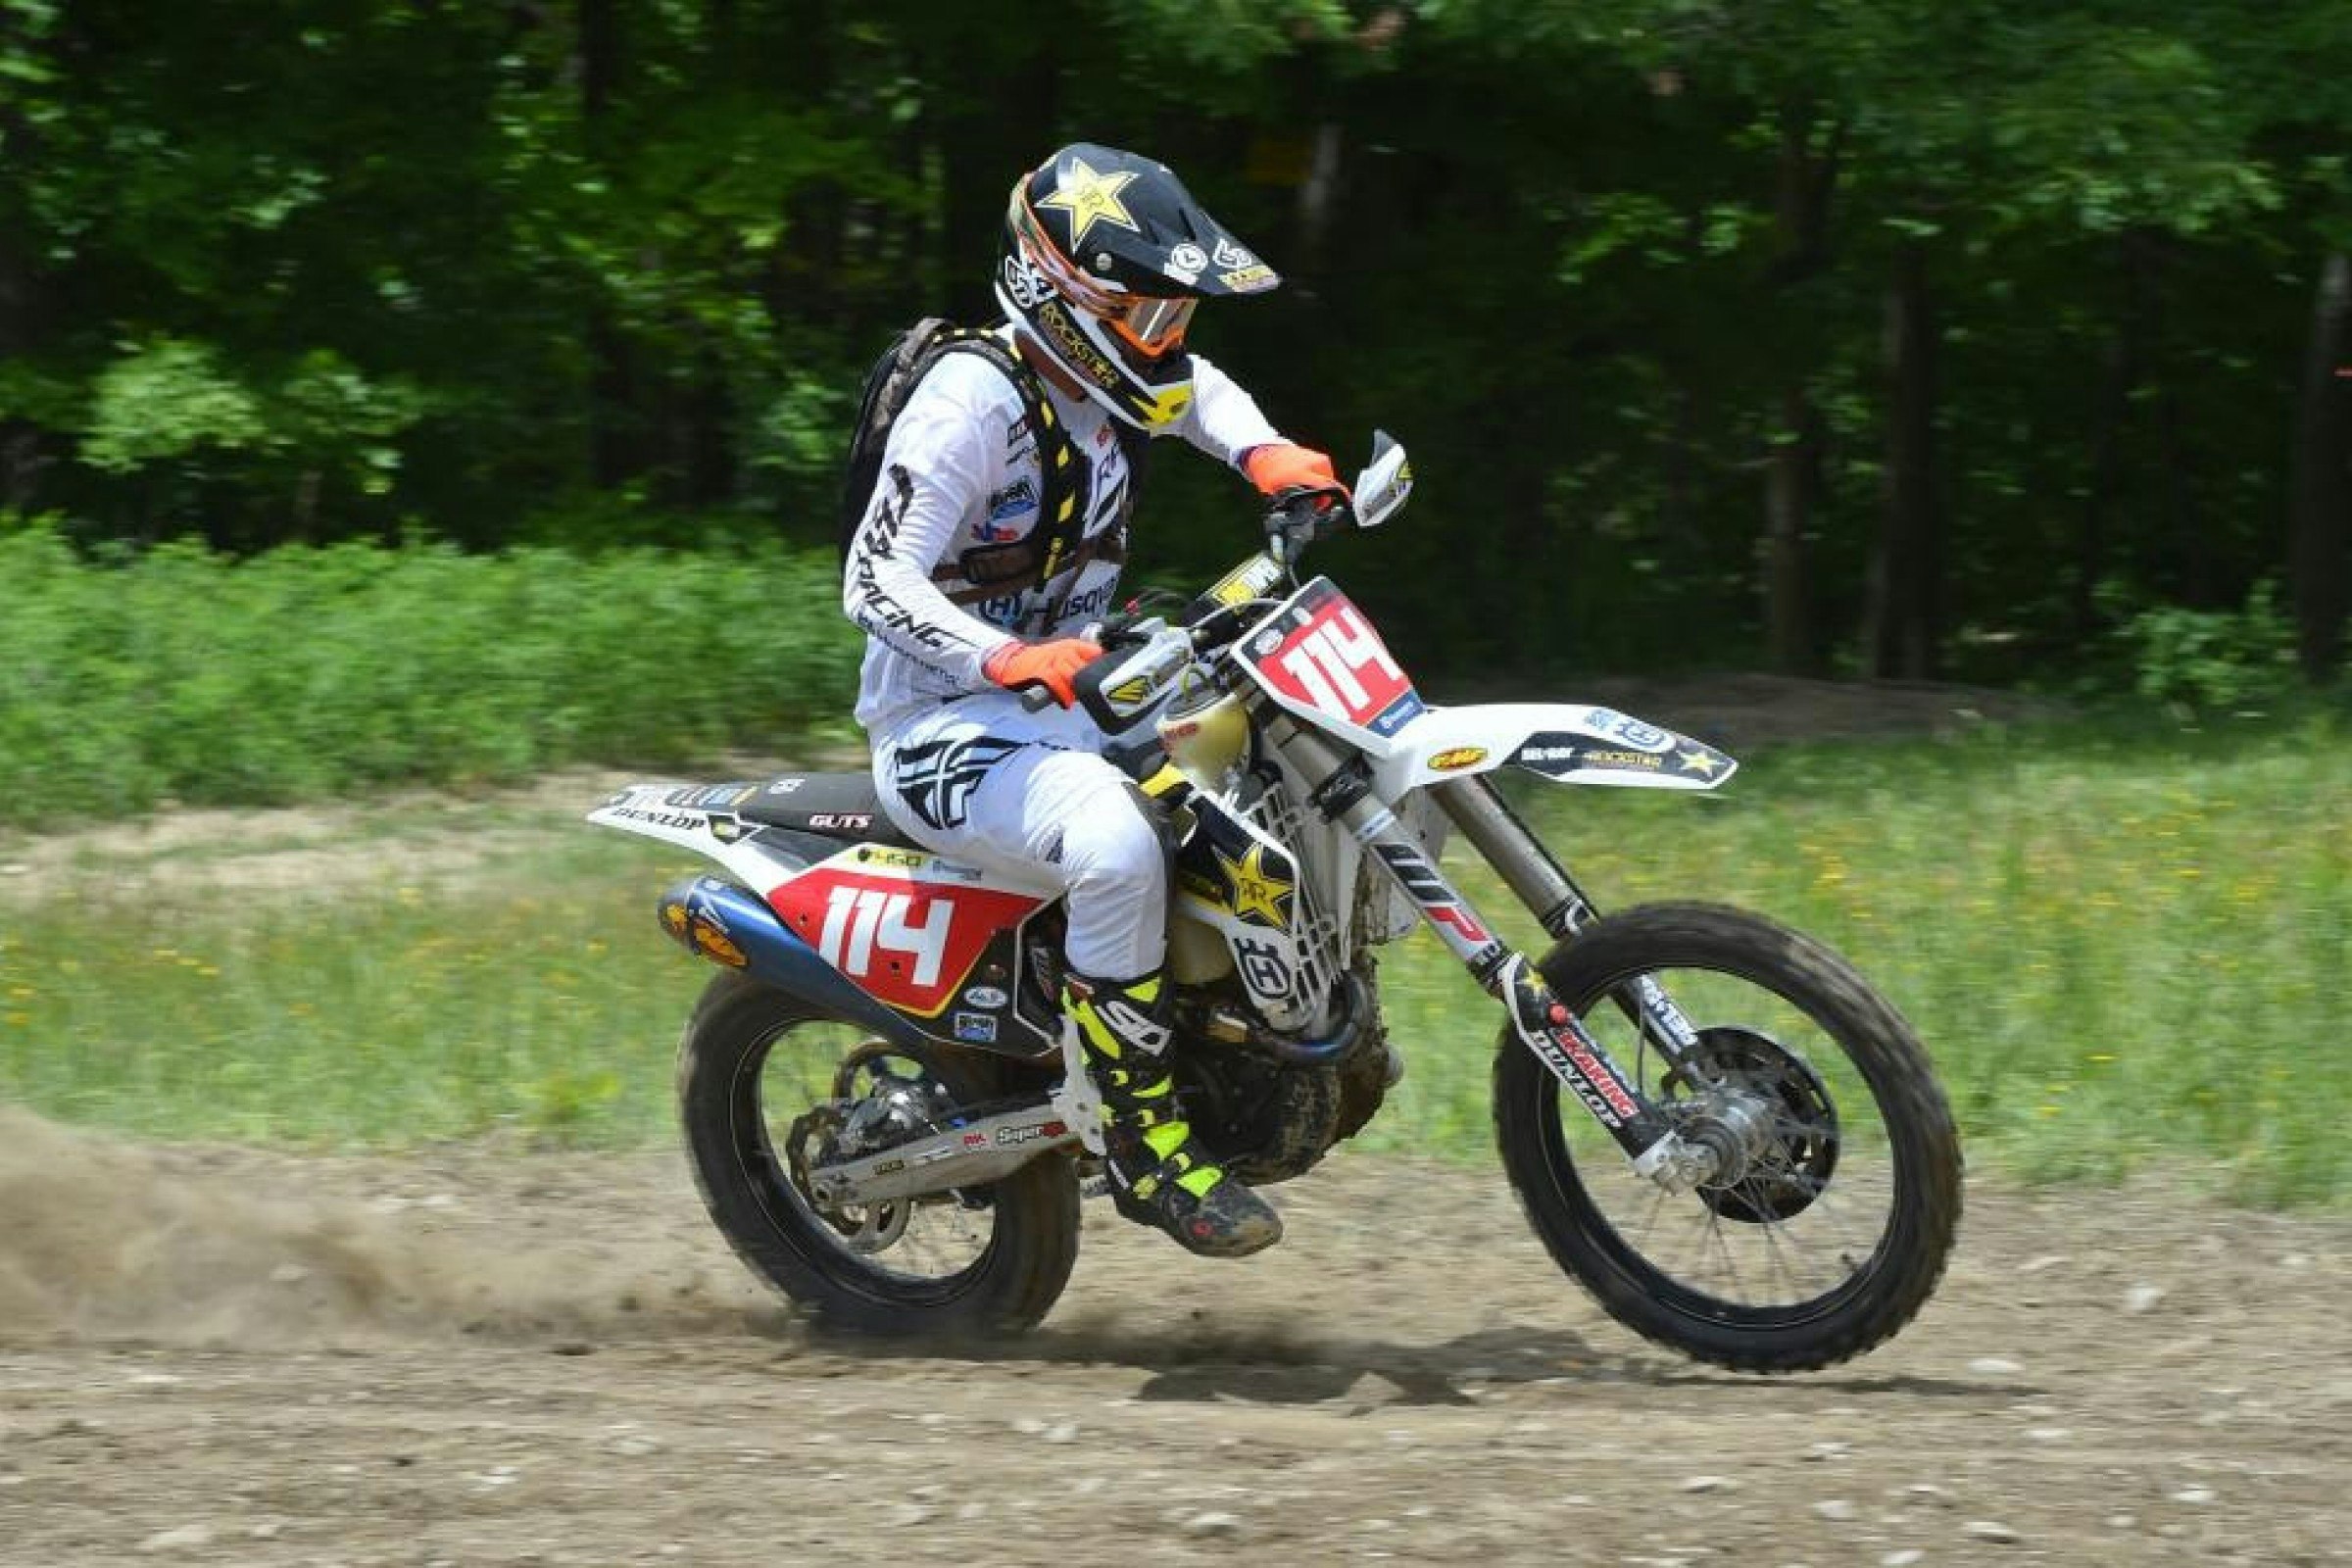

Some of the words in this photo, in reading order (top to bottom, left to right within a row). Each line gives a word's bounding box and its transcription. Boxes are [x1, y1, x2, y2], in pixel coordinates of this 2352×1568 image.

[1281, 606, 1404, 723] 114
[818, 885, 955, 987] 114
[1530, 1029, 1622, 1128] DUNLOP
